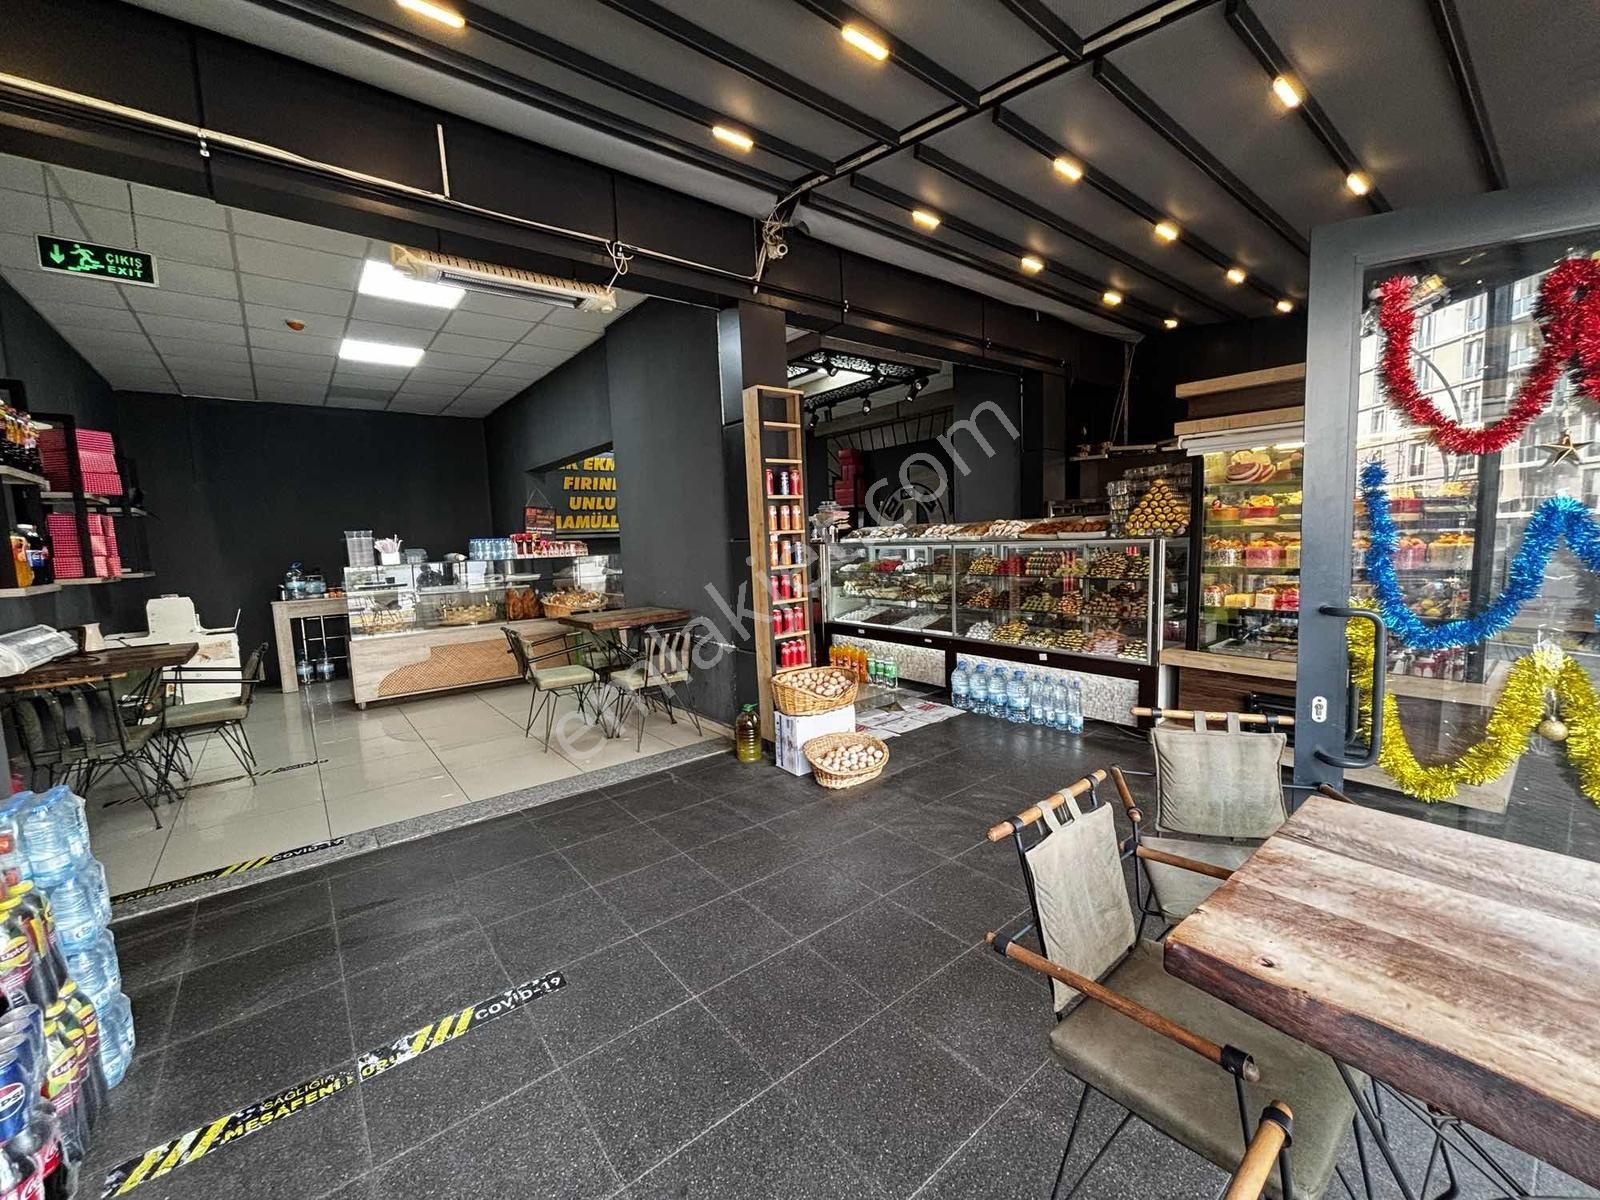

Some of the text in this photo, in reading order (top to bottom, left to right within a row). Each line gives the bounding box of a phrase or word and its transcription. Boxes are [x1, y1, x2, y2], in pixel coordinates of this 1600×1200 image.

[105, 253, 143, 269] ÇIKIŞ
[107, 265, 143, 278] EXIT
[569, 496, 616, 510] UNLU
